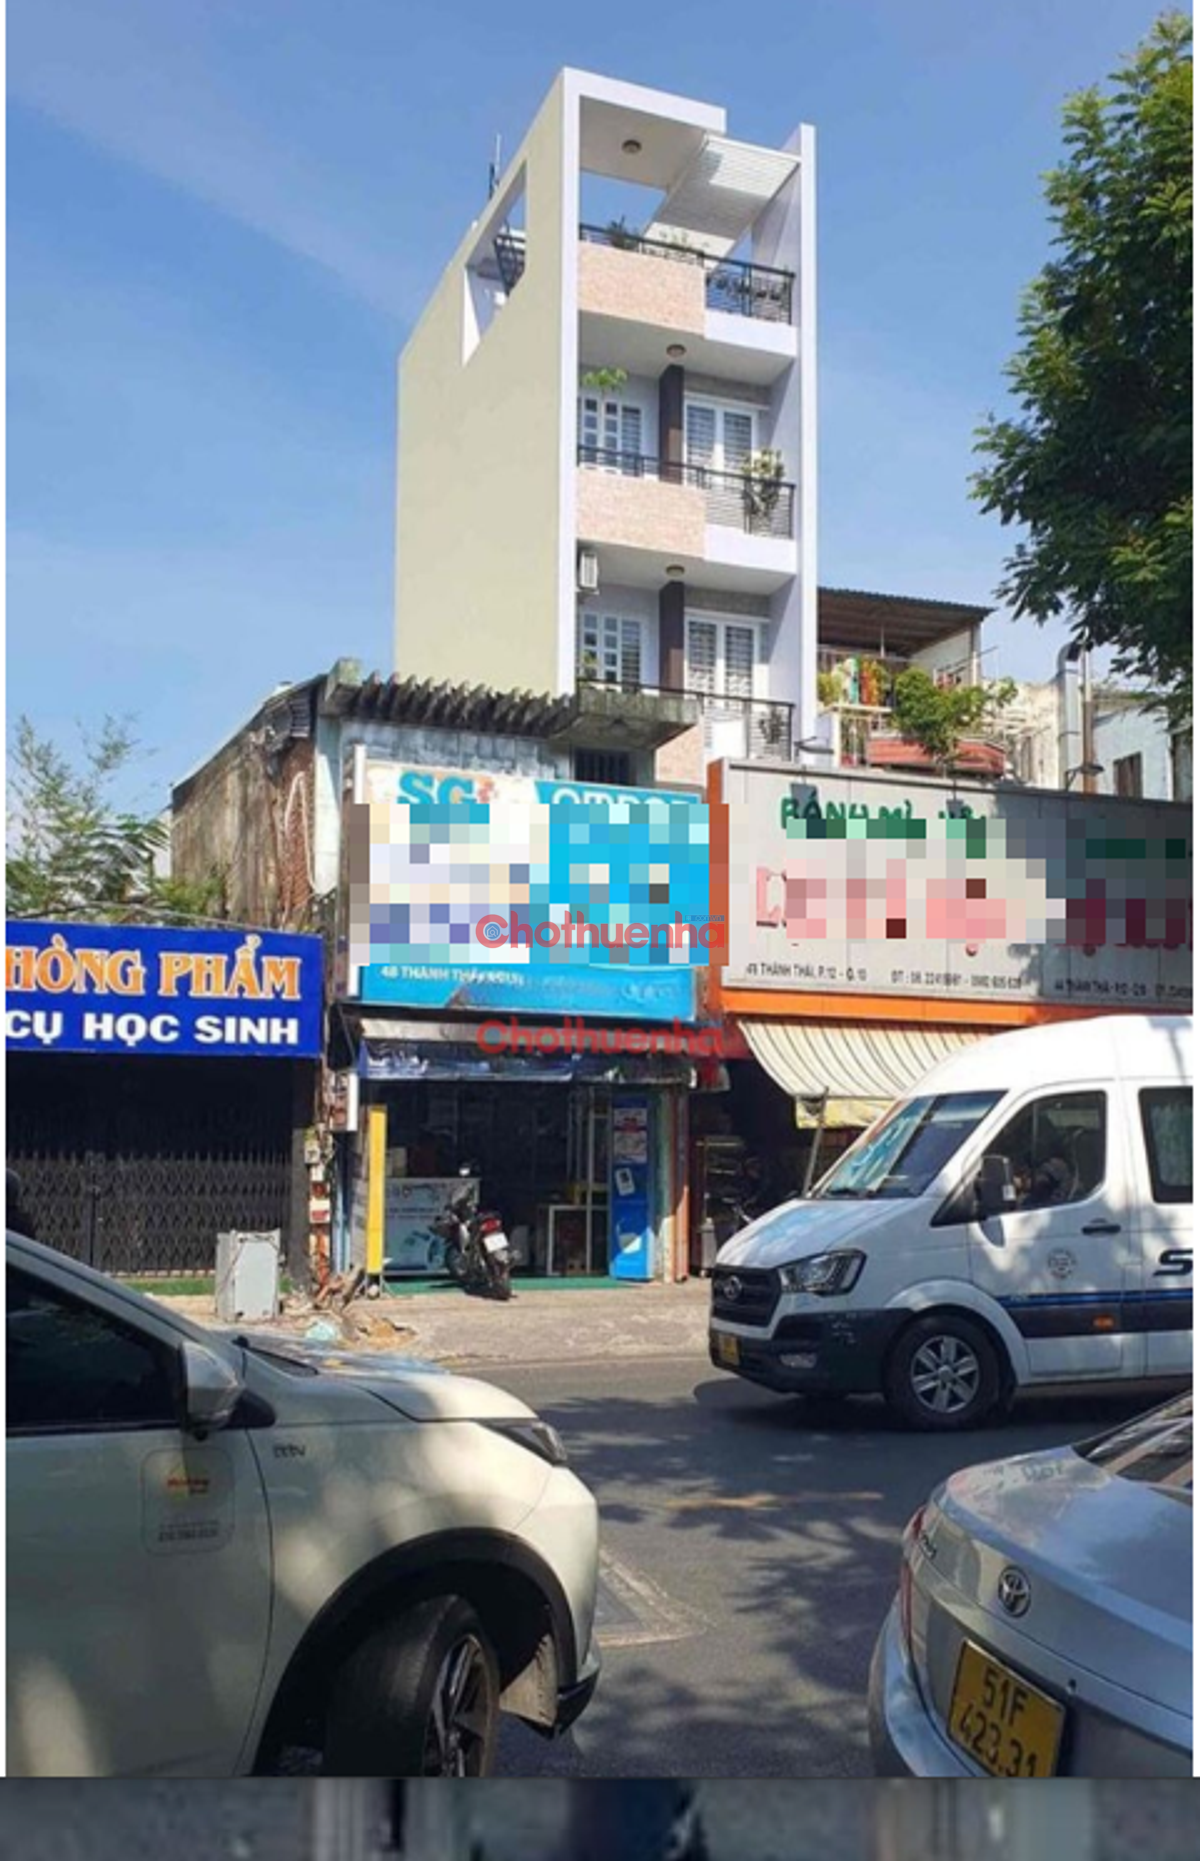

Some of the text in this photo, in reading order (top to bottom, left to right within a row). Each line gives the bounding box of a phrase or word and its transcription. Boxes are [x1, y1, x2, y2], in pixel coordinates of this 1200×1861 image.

[158, 934, 301, 1000] PHẨM
[6, 1011, 298, 1047] CỤ HỌC SINH
[983, 1666, 1028, 1726] 51F
